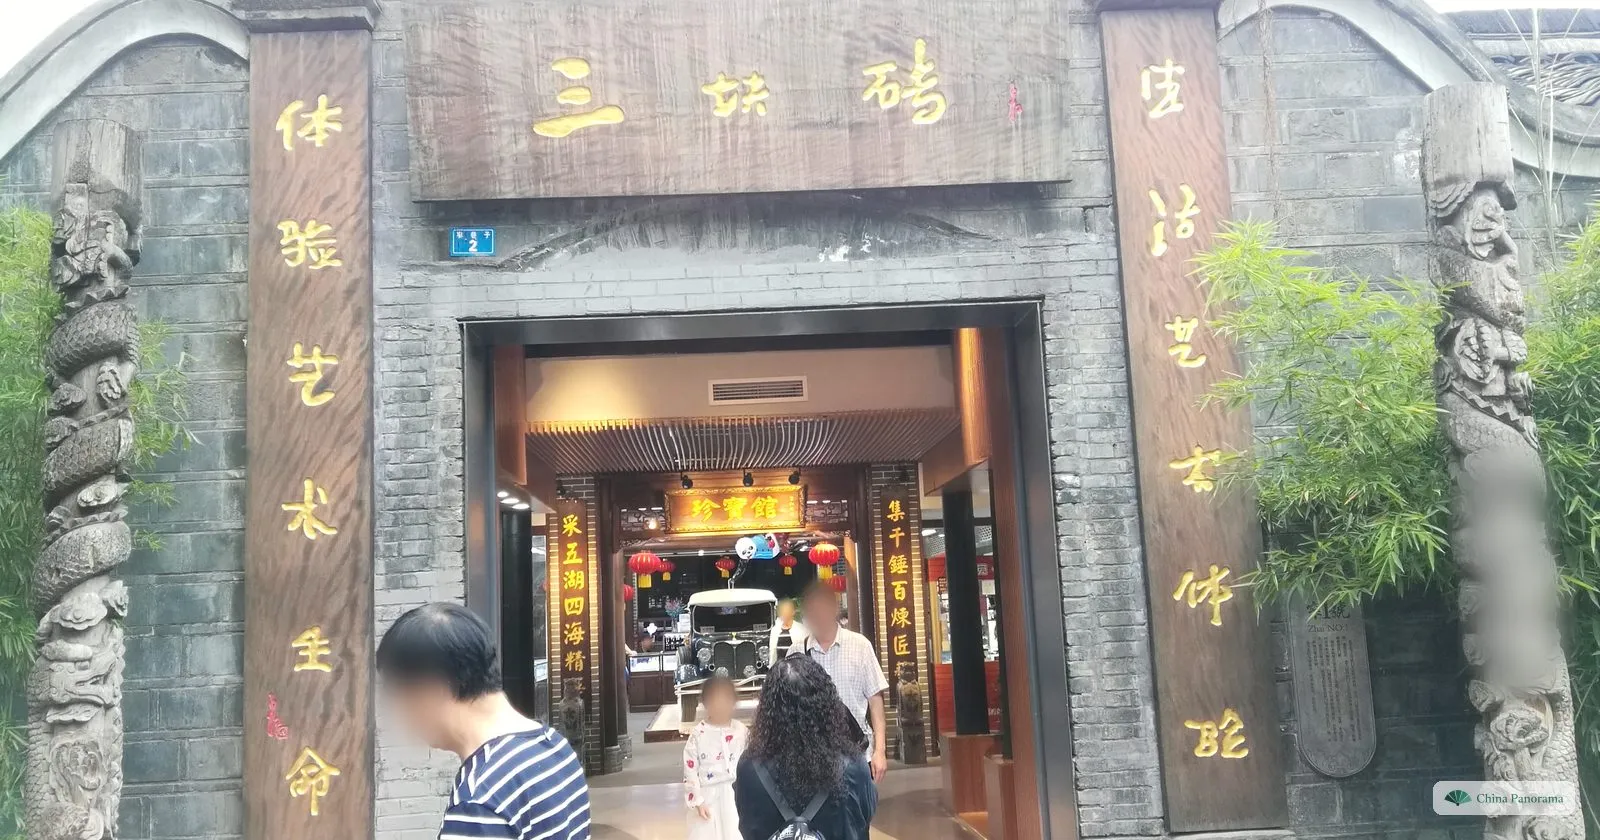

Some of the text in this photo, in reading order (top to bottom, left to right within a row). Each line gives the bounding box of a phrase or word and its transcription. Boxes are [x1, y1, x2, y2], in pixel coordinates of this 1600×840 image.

[533, 39, 947, 137] 三块砖
[468, 239, 478, 252] 2
[274, 93, 342, 818] 体验艺术生命
[690, 496, 779, 522] 珍寶館
